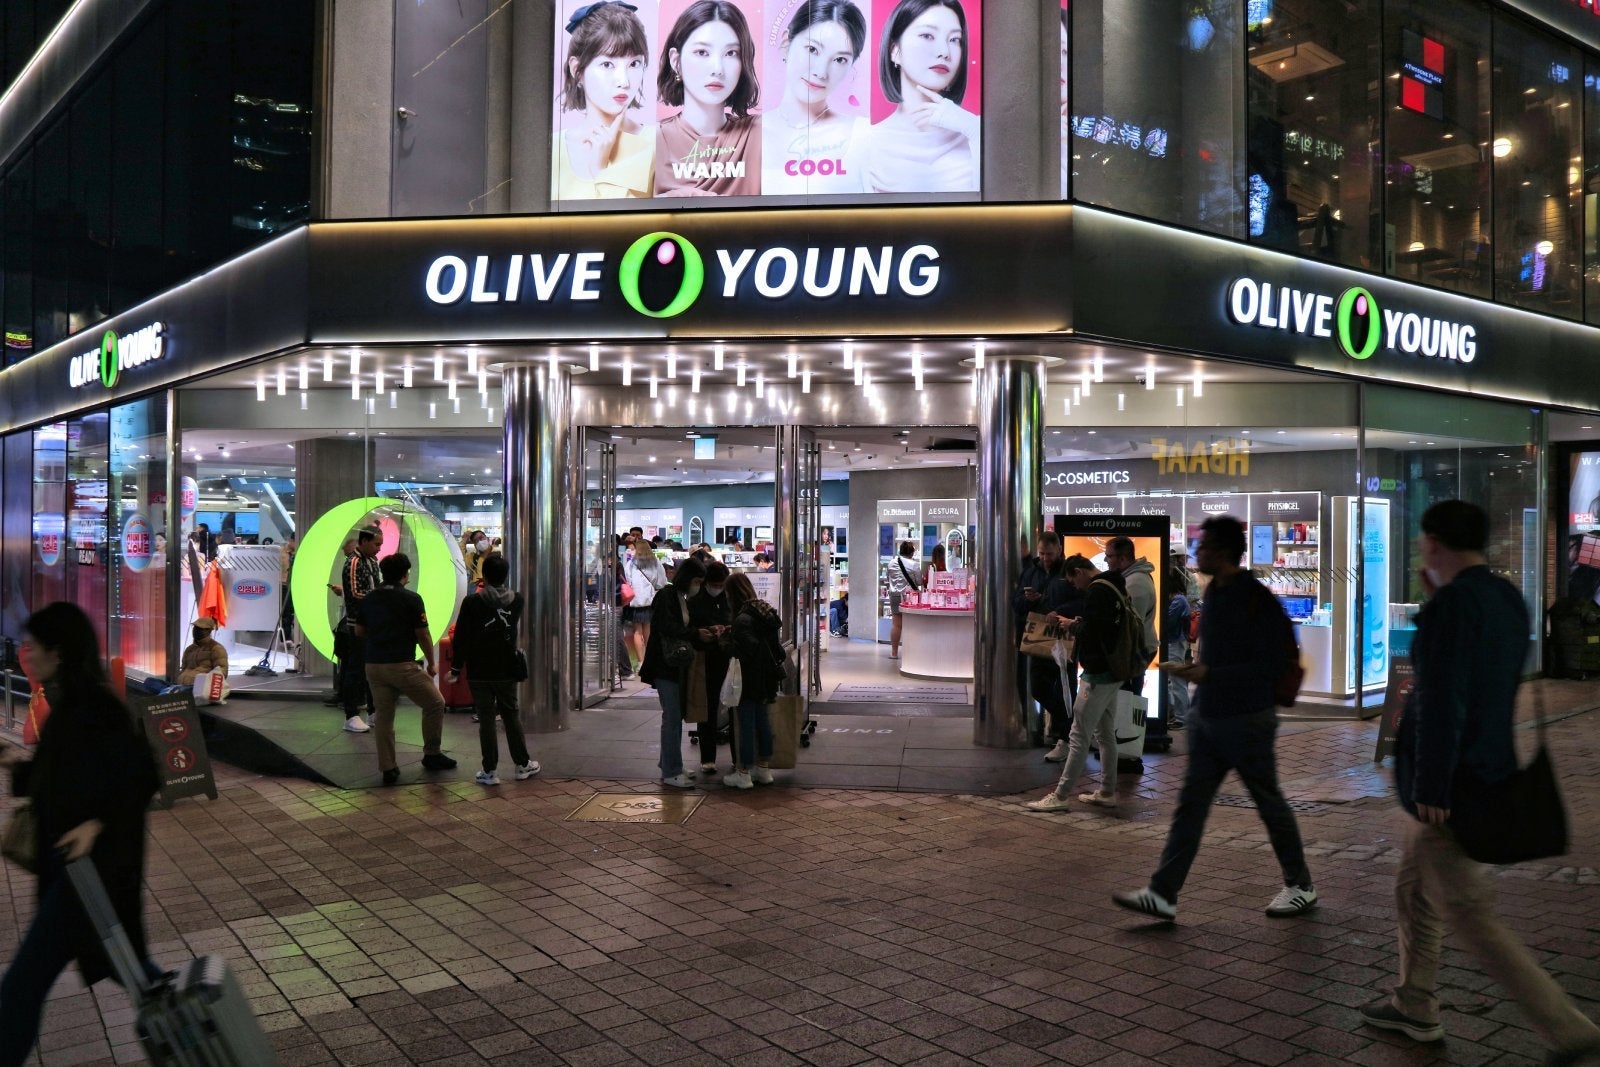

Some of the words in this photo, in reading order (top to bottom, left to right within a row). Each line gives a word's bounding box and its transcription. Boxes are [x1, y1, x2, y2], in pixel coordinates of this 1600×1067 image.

[769, 8, 789, 47] SUMMER
[672, 161, 746, 179] WARM
[784, 159, 847, 177] COOL
[425, 252, 604, 304] OLIVE
[715, 244, 940, 298] YOUNG
[1232, 278, 1333, 337] OLIVE
[1383, 309, 1476, 363] YOUNG
[69, 347, 101, 388] OLIVE
[117, 321, 162, 371] YOUNG
[1140, 506, 1166, 516] Avène
[1201, 501, 1230, 511] Eucerin
[1267, 502, 1300, 510] PHYSIOGEL
[78, 550, 96, 564] READY
